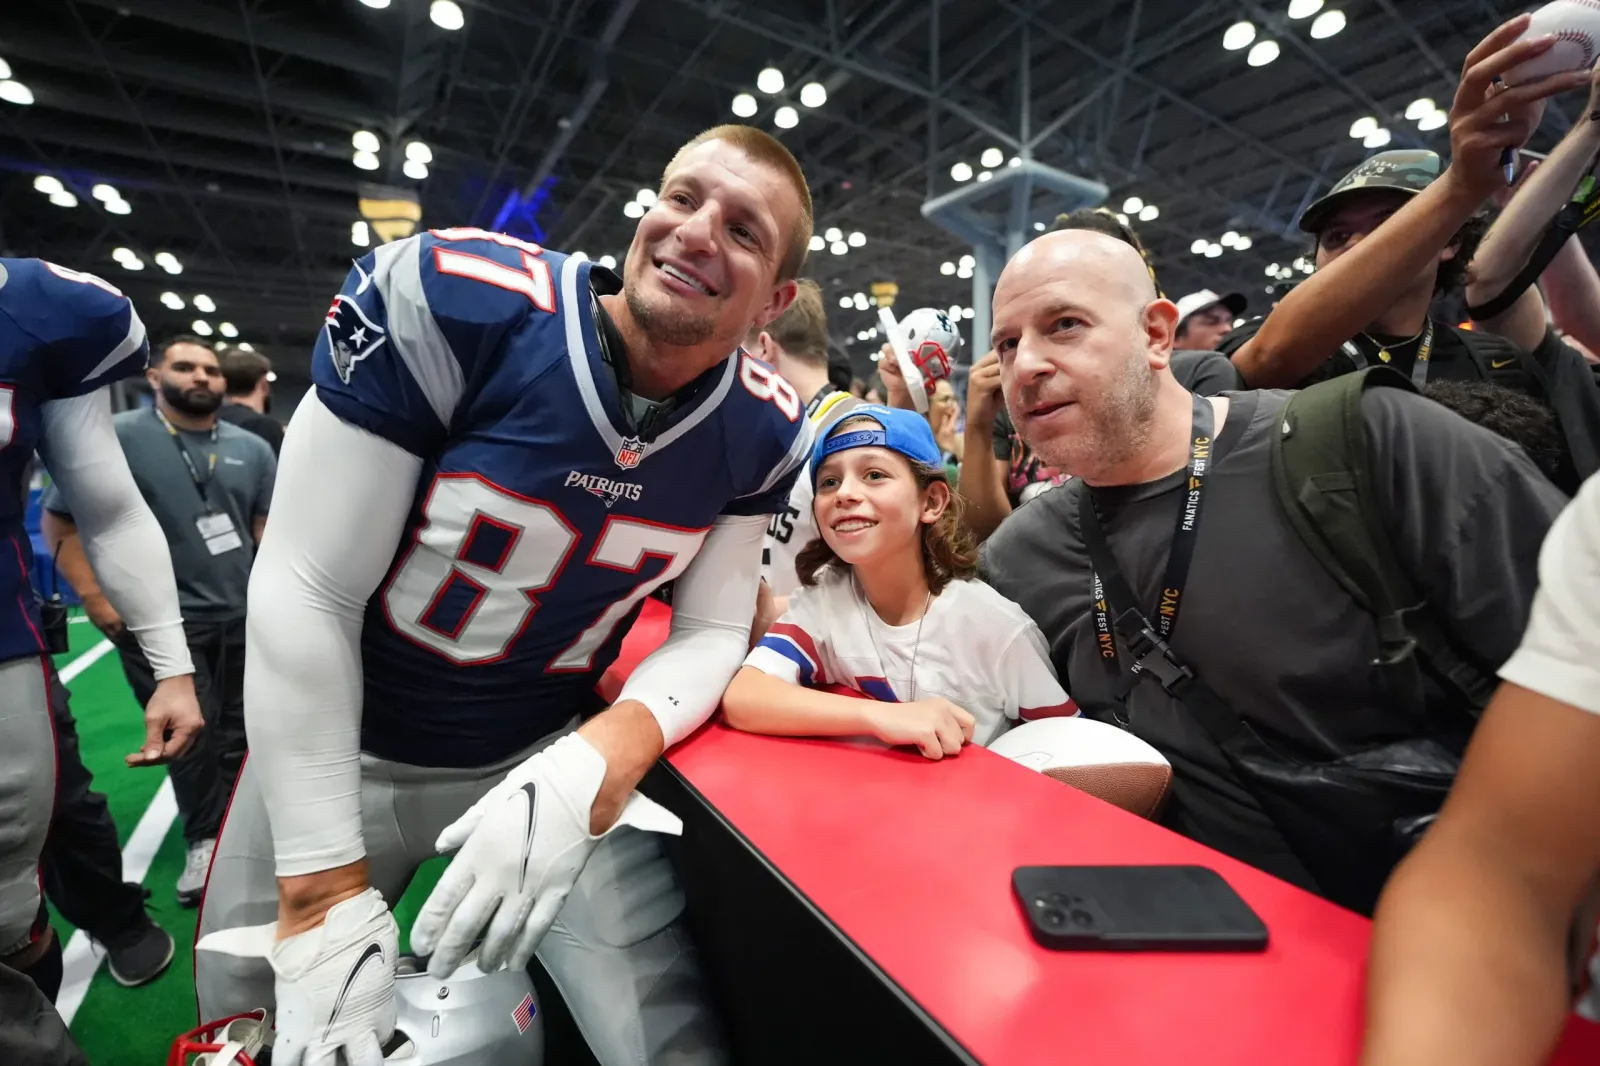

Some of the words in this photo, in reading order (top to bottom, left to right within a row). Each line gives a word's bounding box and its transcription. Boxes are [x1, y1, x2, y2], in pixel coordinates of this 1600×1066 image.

[618, 450, 639, 466] NFL
[1193, 437, 1210, 458] NYC
[1193, 459, 1206, 476] FEST
[564, 470, 643, 501] PATRIOTS
[1182, 490, 1200, 531] FANATICS
[381, 472, 712, 674] 87
[1160, 588, 1179, 617] NYC
[1096, 612, 1108, 632] FEST
[1160, 616, 1171, 635] FEST
[1098, 633, 1115, 658] NYC
